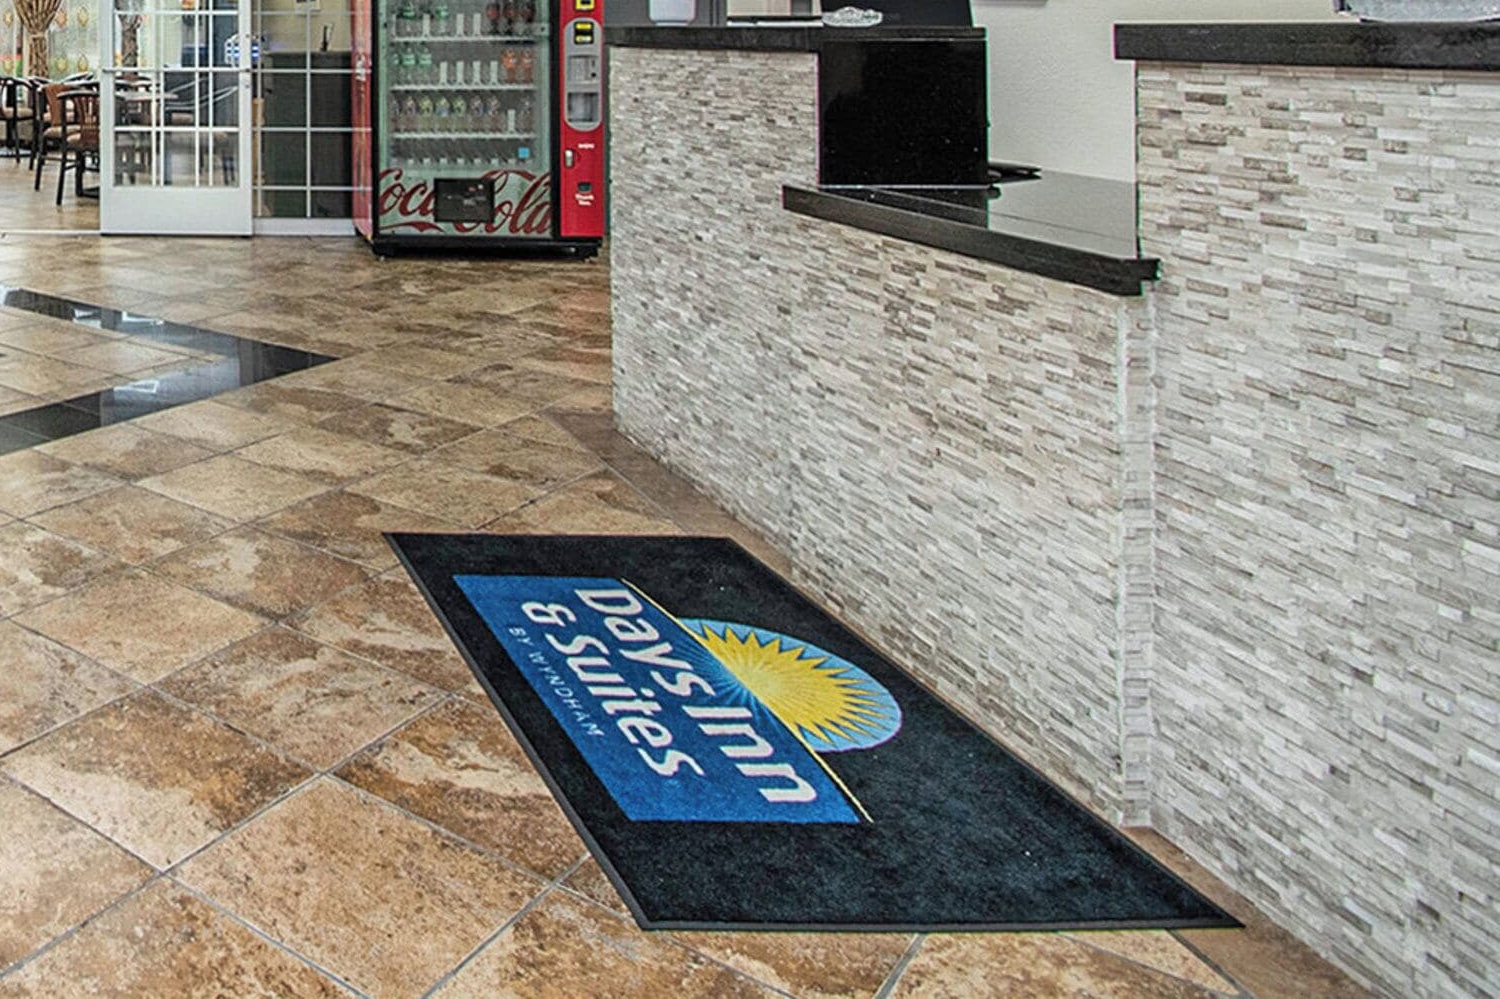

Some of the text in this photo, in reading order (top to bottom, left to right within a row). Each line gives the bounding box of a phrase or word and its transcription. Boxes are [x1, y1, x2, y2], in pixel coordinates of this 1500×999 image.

[508, 626, 605, 738] BY WYNDHAM
[521, 601, 704, 776] & Suites
[574, 588, 817, 803] Days Inn
